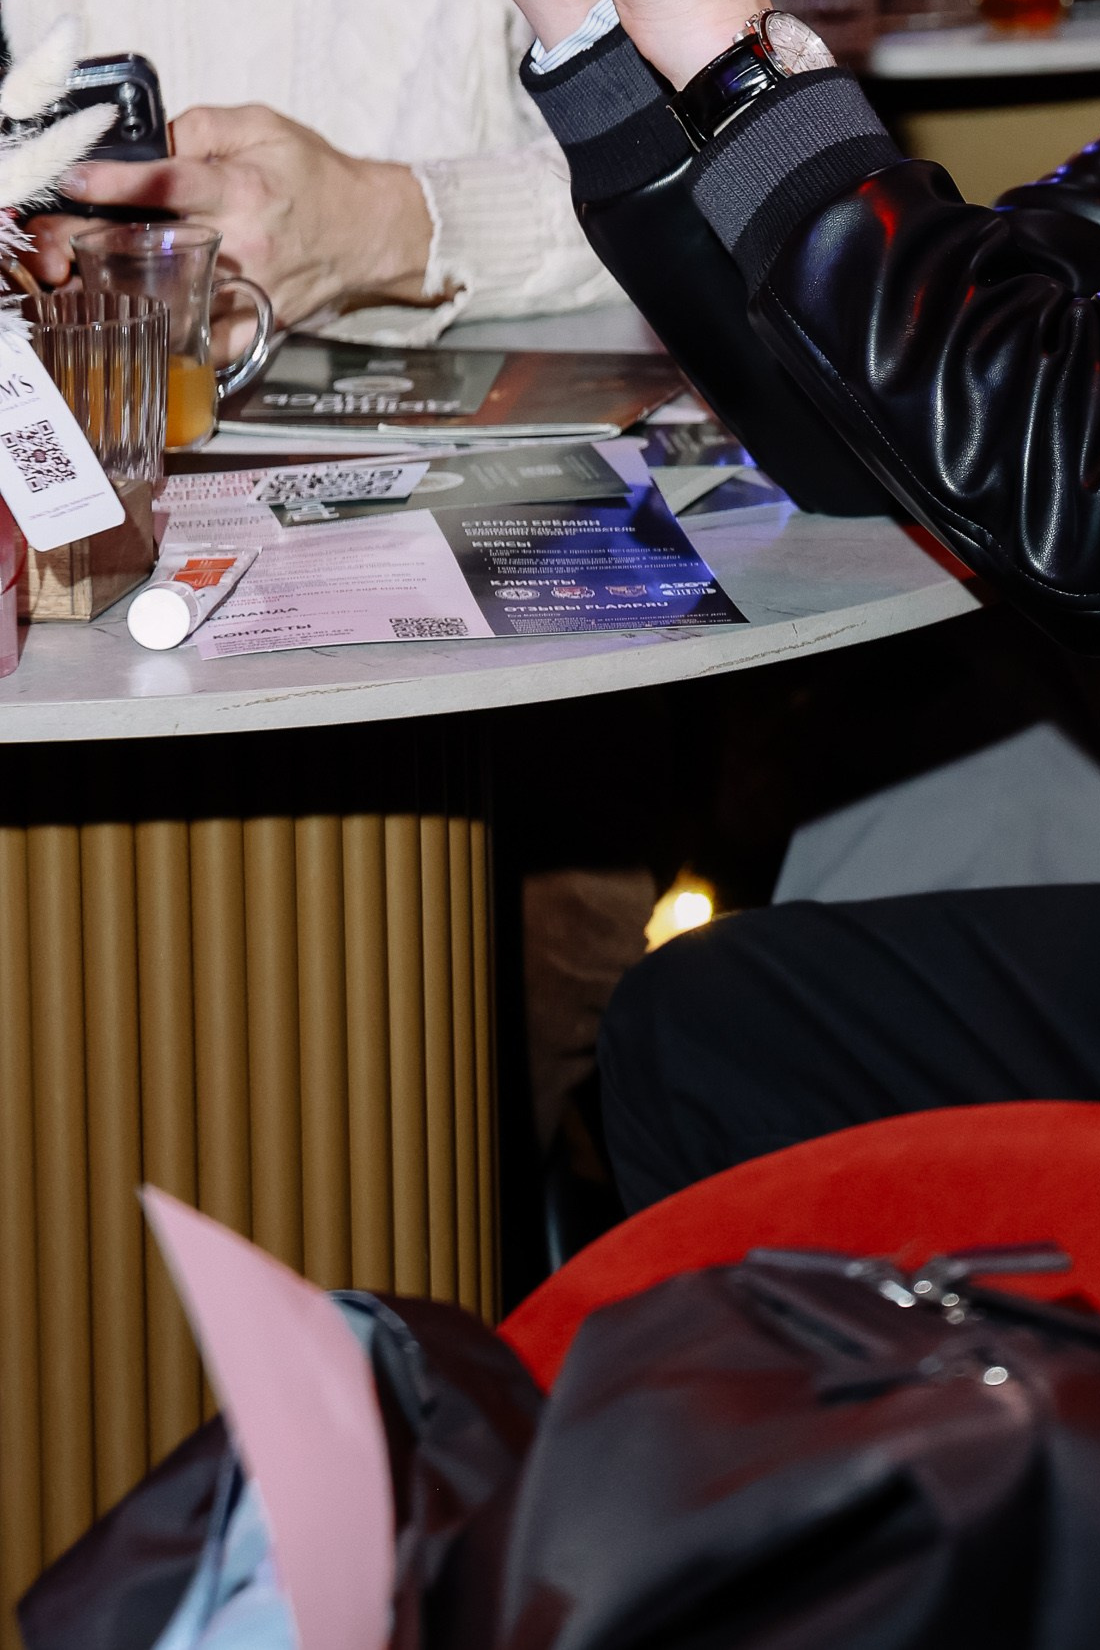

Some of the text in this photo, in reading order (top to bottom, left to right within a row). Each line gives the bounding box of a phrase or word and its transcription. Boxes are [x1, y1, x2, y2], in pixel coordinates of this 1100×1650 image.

[585, 601, 669, 610] FLAMP.RU
[206, 607, 299, 621] КОМАНДА
[213, 624, 311, 639] КОНТАКТЫ
